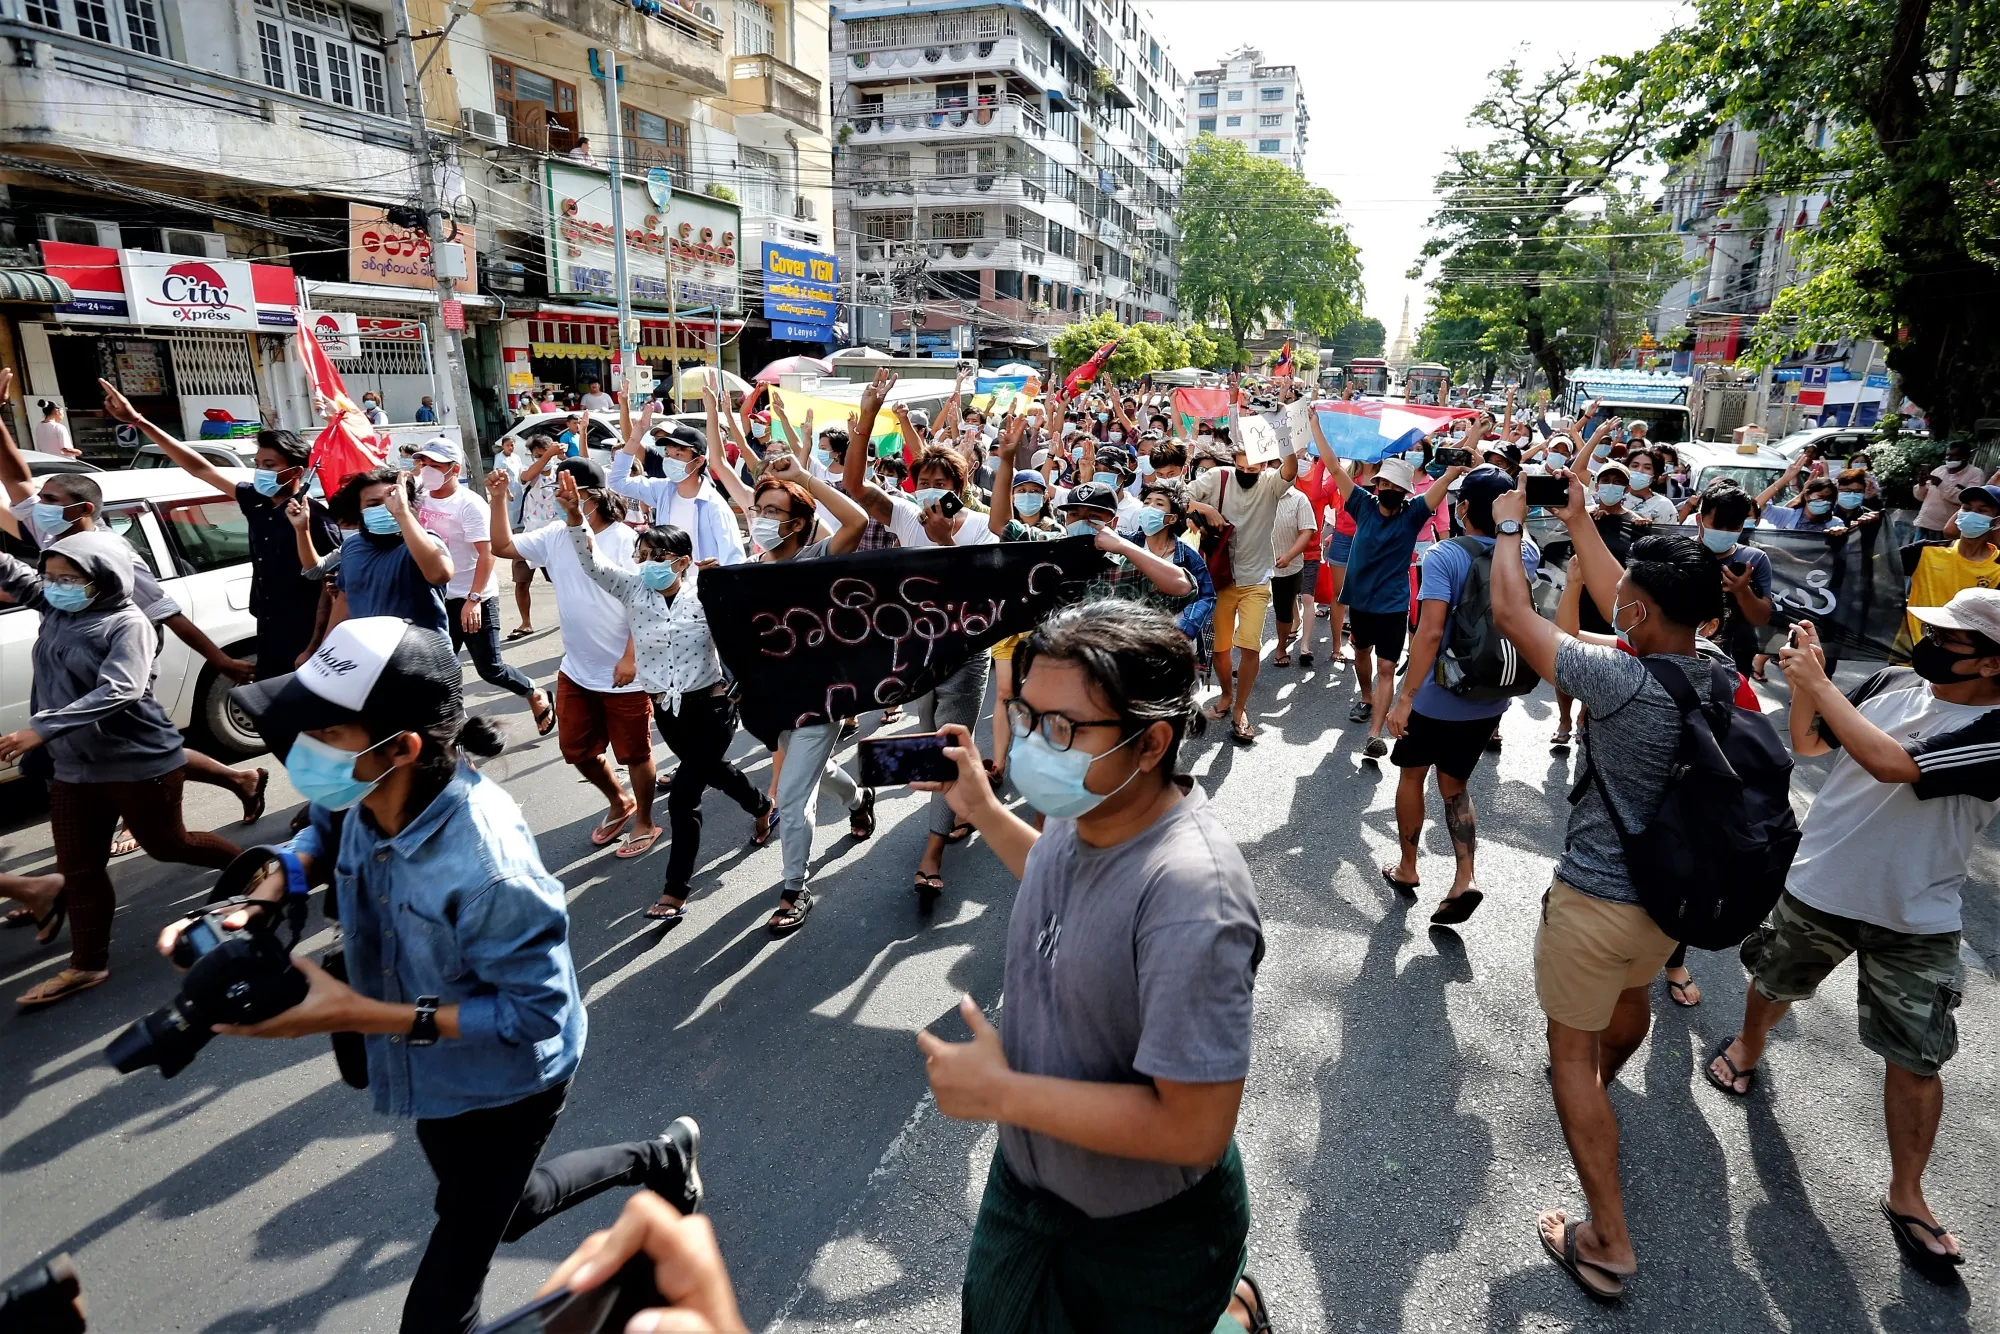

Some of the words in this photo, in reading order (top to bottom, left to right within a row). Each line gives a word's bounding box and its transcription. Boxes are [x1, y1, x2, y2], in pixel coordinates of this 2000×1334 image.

[769, 250, 806, 277] Cover
[809, 259, 834, 282] YGN
[572, 266, 614, 294] MOE
[162, 276, 229, 309] City
[87, 302, 99, 310] 24
[173, 307, 231, 322] eXpress
[1811, 368, 1823, 383] P
